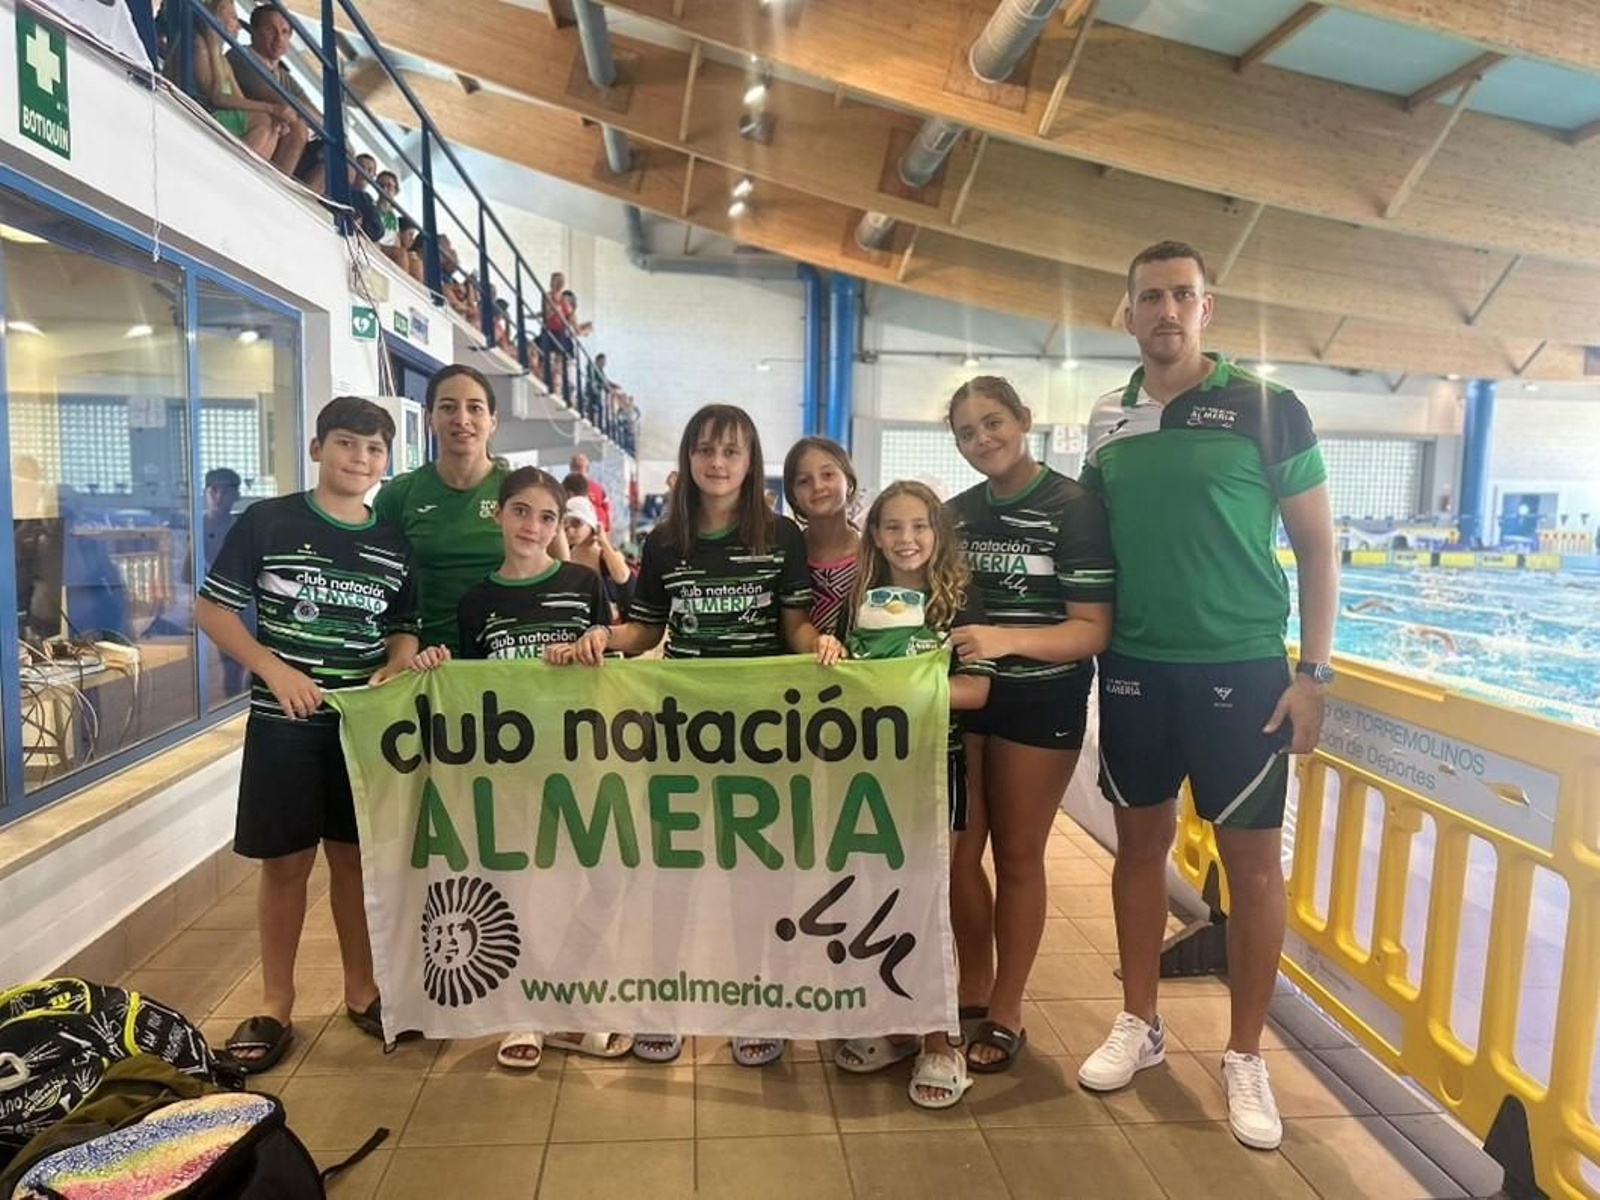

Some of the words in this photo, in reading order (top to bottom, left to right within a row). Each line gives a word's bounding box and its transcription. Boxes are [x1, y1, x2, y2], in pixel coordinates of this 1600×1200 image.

[23, 104, 69, 152] BOTIQUÍN
[965, 554, 1028, 574] MERIA
[970, 540, 1031, 554] natación
[296, 571, 328, 587] club
[330, 577, 385, 599] natación
[706, 582, 763, 596] natación
[519, 628, 578, 645] natación
[380, 690, 535, 774] club
[563, 684, 909, 763] natación
[1355, 709, 1487, 776] TORREMOLINOS
[1366, 745, 1437, 790] Deportes
[410, 771, 906, 873] ALMERIA
[520, 970, 867, 1011] www.cnalmeria.com
